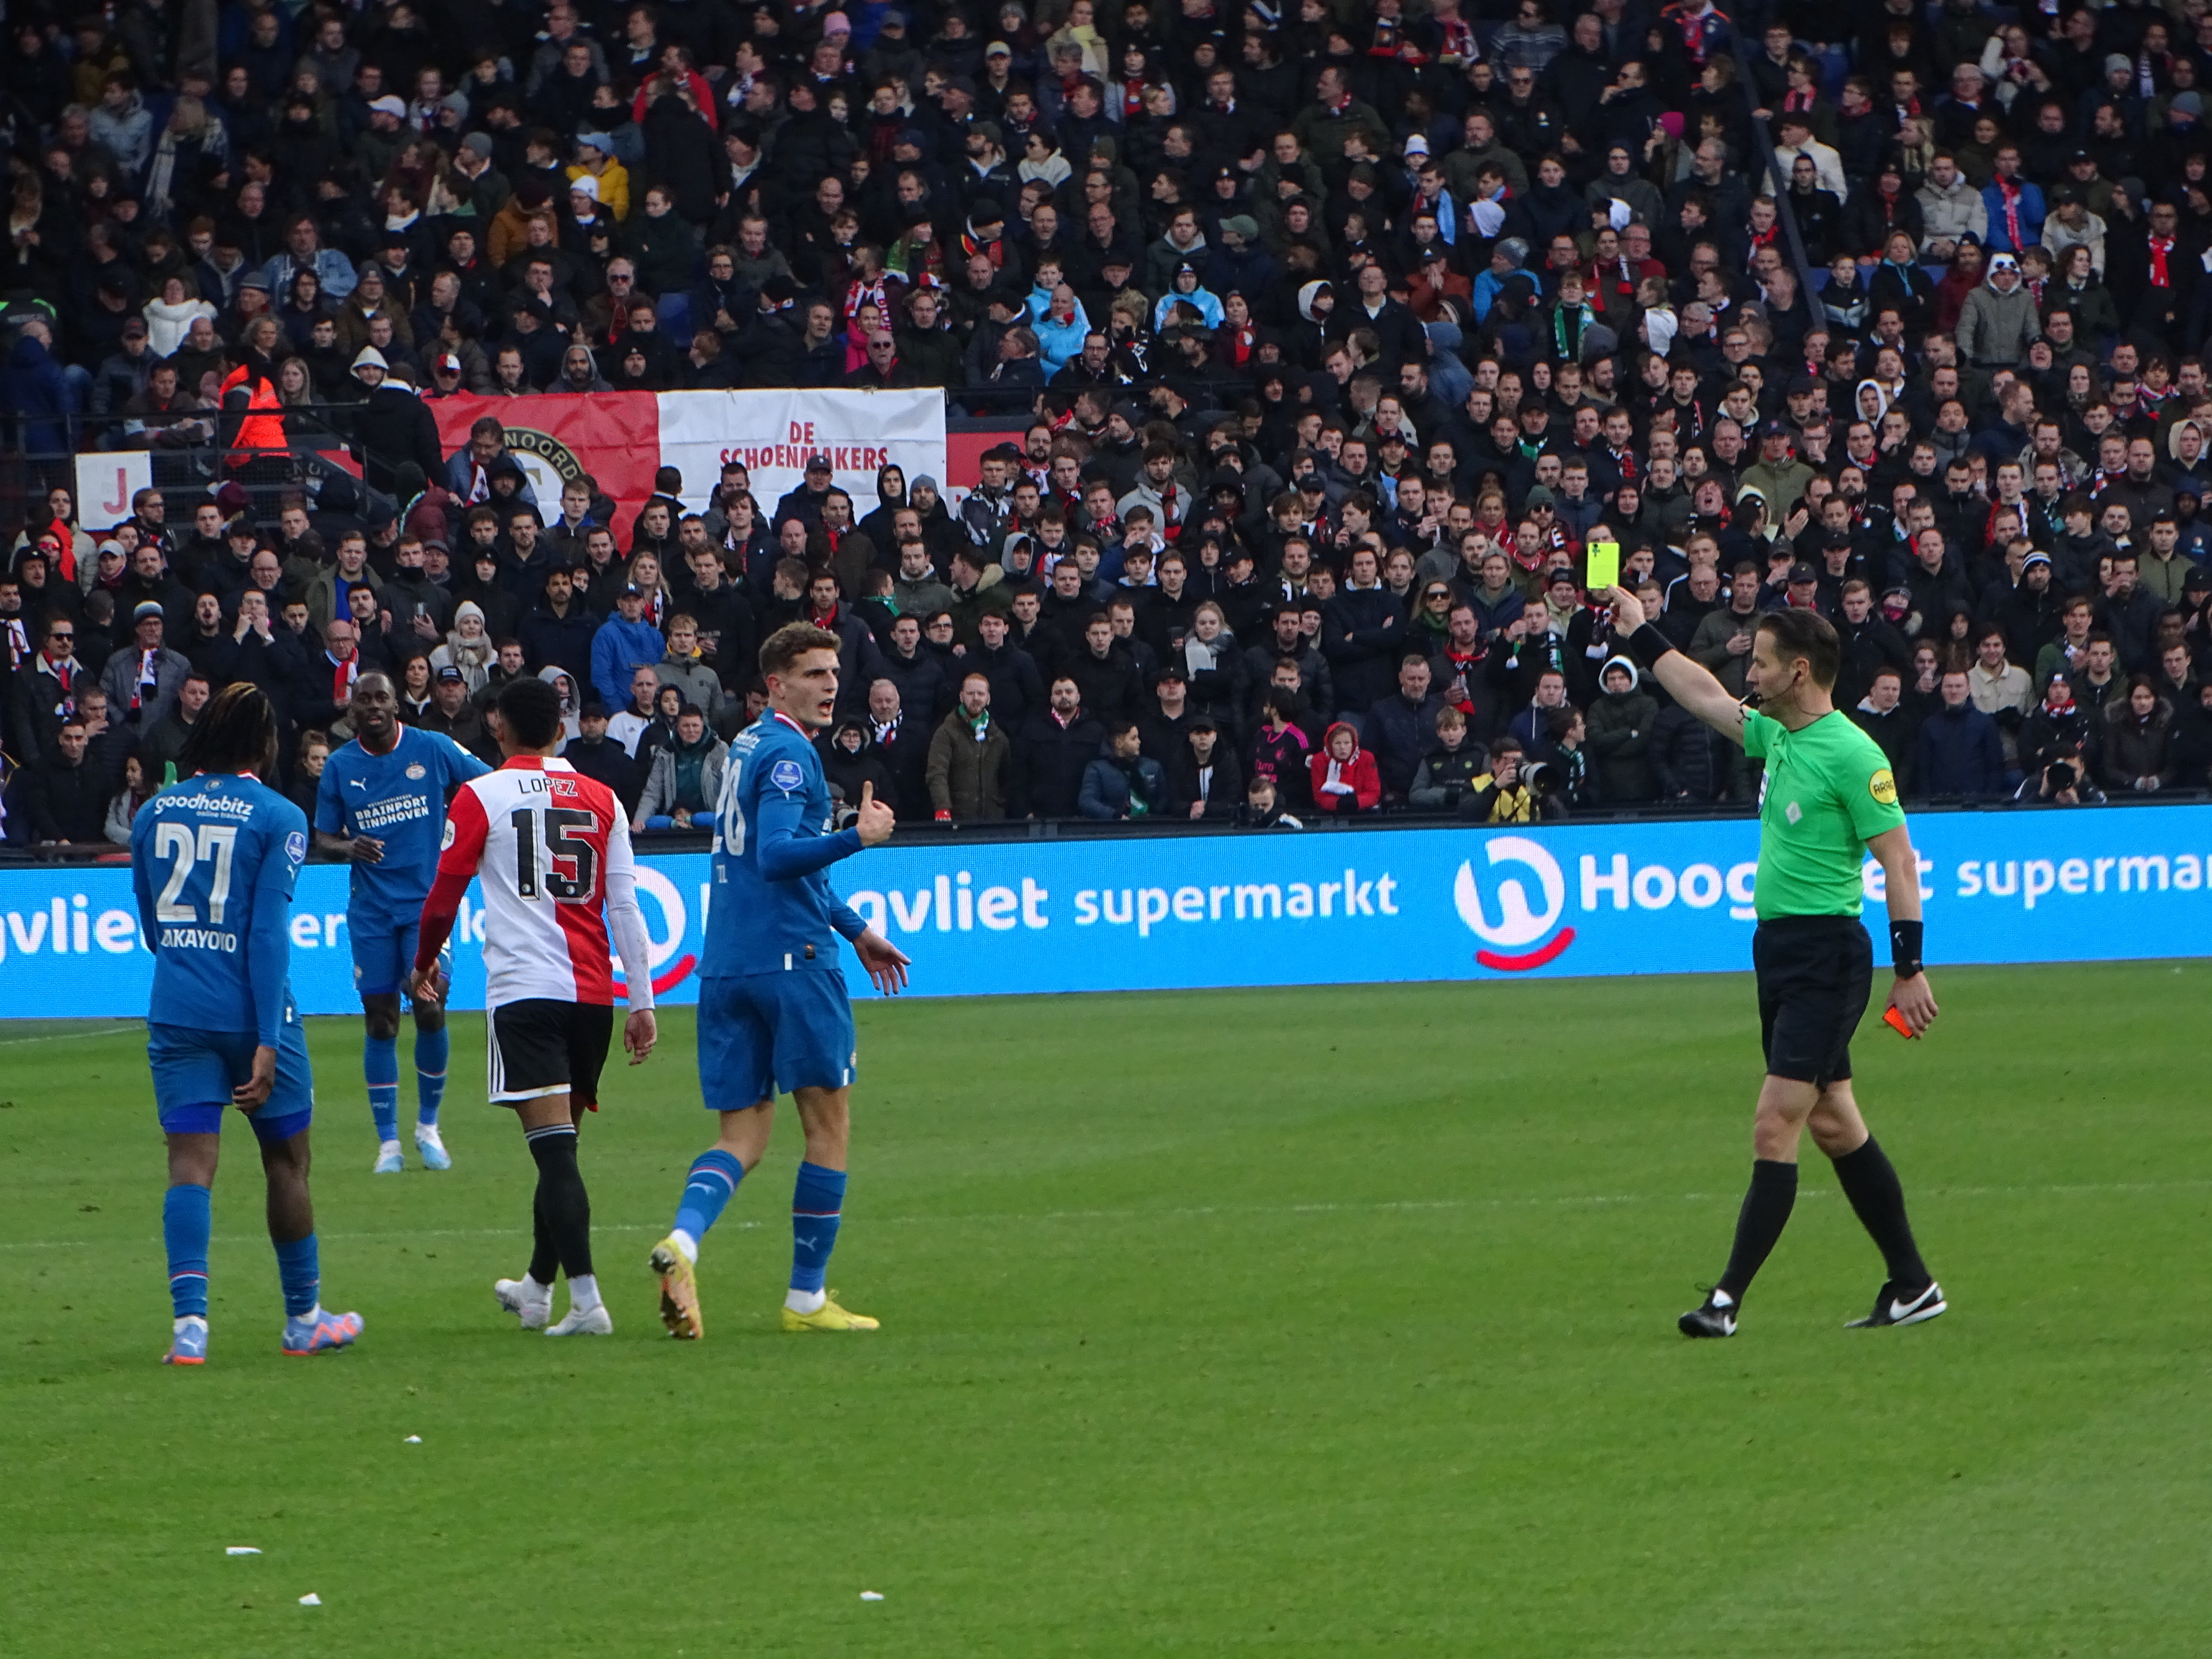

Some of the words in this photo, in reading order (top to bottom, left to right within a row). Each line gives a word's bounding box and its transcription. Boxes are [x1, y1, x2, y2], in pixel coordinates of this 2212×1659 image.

[503, 432, 578, 480] NOORD
[790, 421, 815, 445] DE
[720, 444, 888, 471] SCHOENMAKERS
[103, 468, 127, 515] J
[154, 792, 253, 816] goodhabitz
[355, 794, 427, 820] BRAINPORT
[518, 778, 578, 797] LOPEZ
[358, 805, 429, 830] EINDHOVEN
[155, 822, 238, 925] 27
[511, 808, 599, 905] 15
[1075, 869, 1399, 938] supermarkt
[1580, 853, 1934, 922] Hooget
[0, 893, 154, 964] vlie
